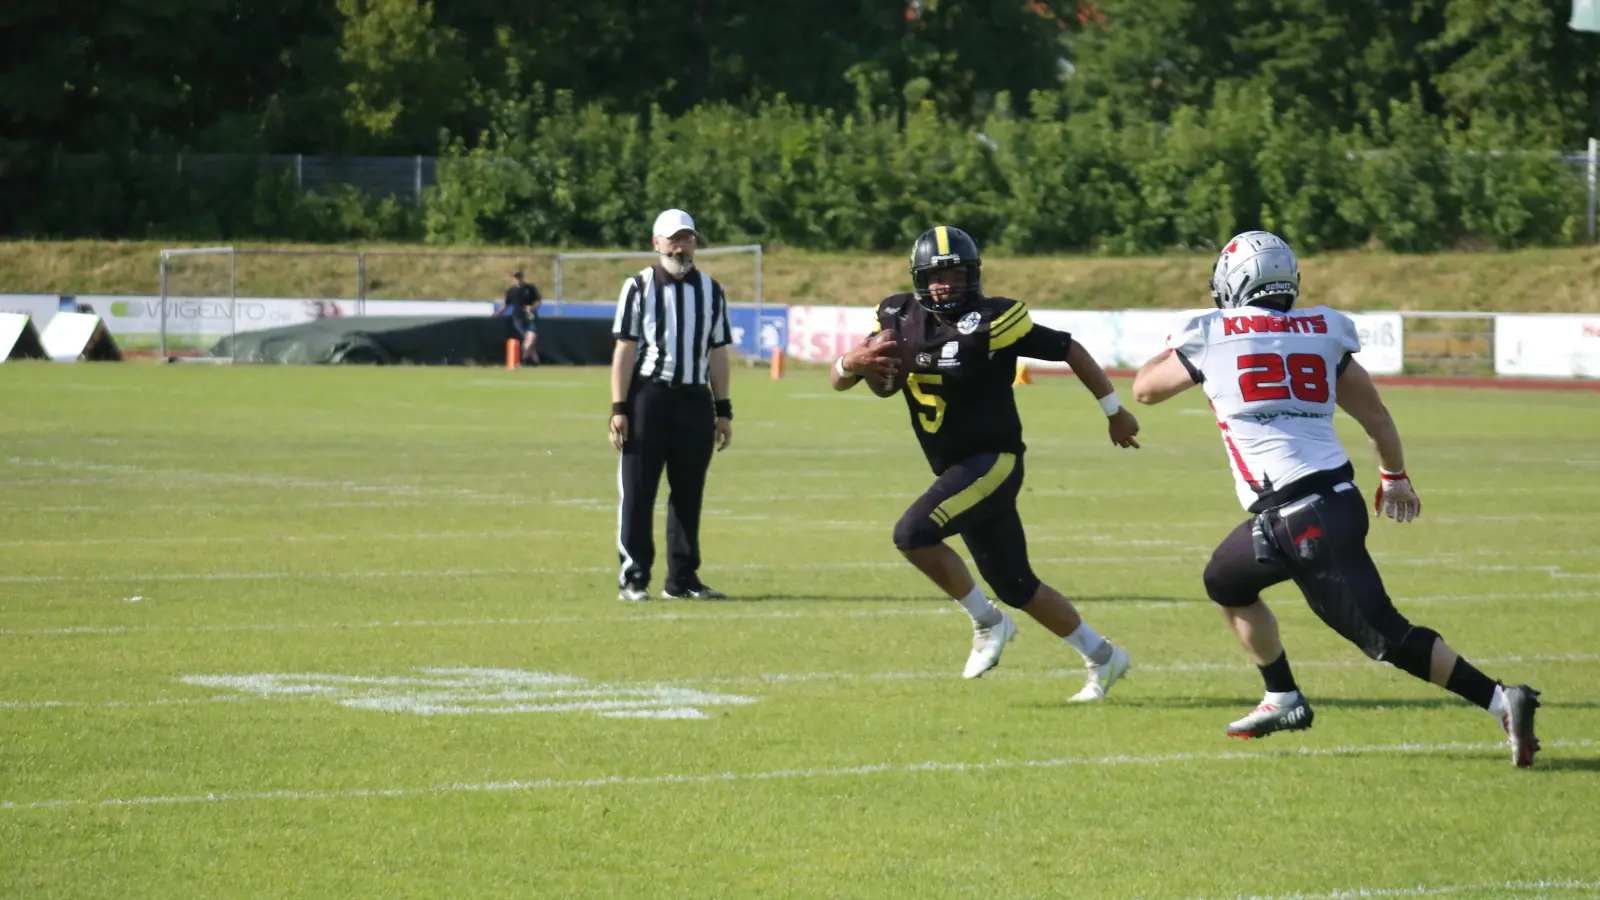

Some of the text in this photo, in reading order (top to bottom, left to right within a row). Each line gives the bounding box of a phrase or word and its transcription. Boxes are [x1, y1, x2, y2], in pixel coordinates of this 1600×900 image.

[1223, 314, 1328, 337] KNIGHTS
[907, 372, 947, 434] 5
[1237, 353, 1329, 403] 28
